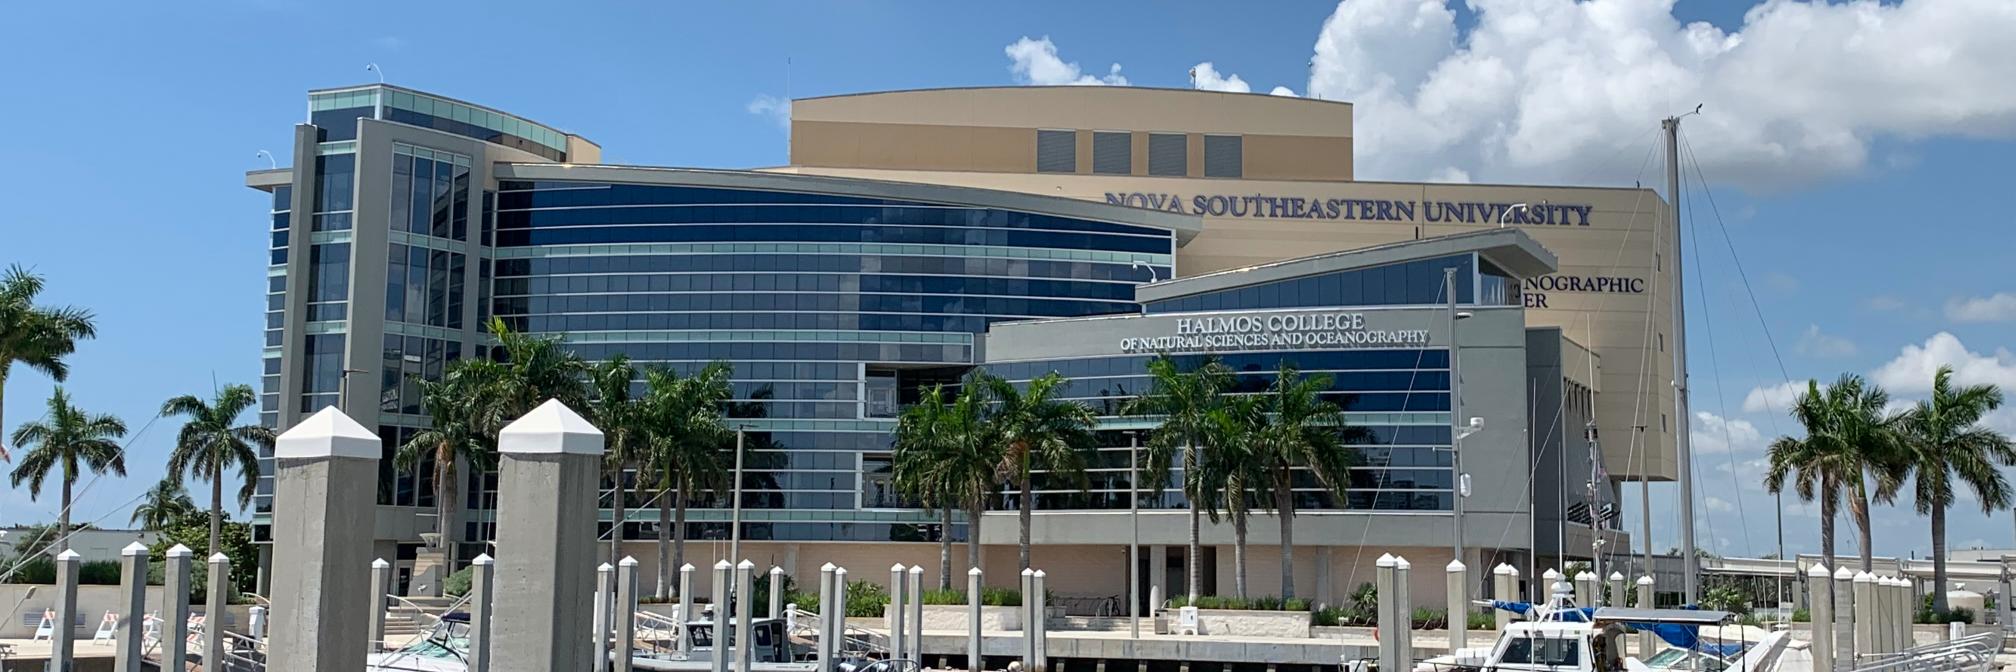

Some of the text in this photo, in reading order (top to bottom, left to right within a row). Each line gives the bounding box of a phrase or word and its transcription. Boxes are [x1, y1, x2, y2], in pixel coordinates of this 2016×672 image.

[1193, 194, 1416, 222] SOUTHEASTERN
[1423, 201, 1593, 226] UNIVERSITY
[1177, 313, 1365, 334] HALMOS COLLEGE
[1120, 329, 1429, 350] OF NATURAL SCIENCES AND OCEANOGRAPHY
